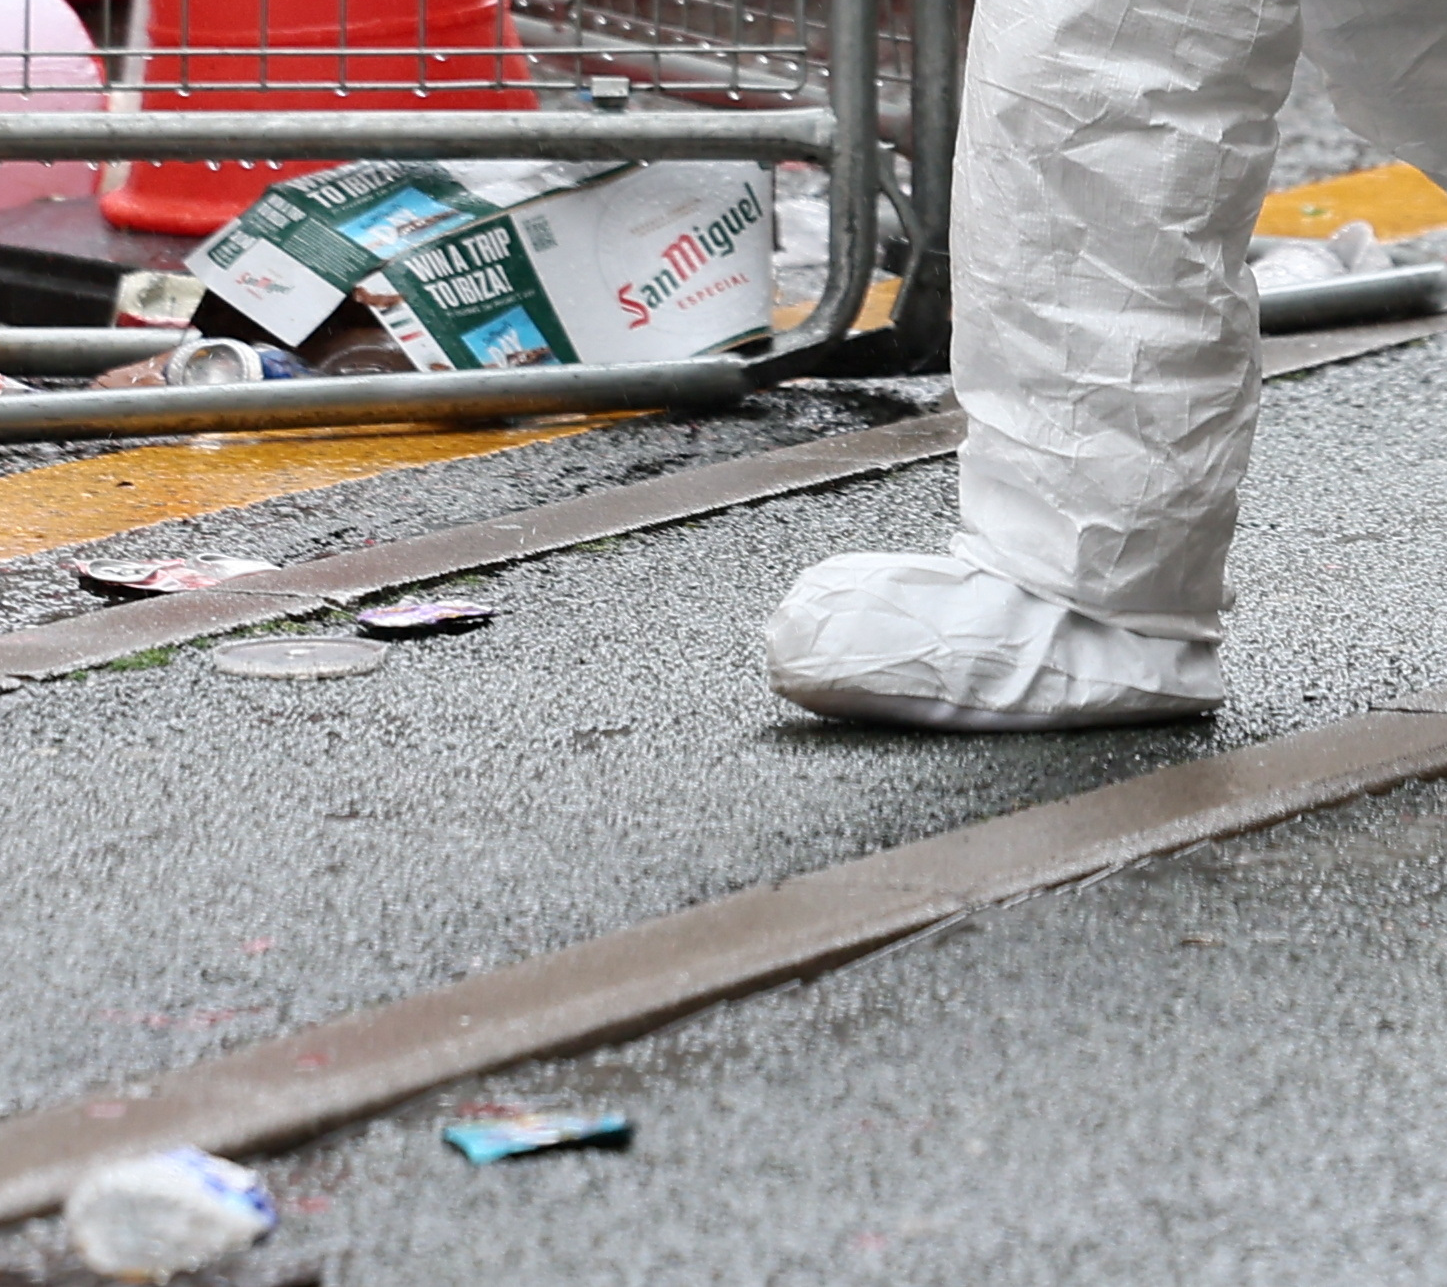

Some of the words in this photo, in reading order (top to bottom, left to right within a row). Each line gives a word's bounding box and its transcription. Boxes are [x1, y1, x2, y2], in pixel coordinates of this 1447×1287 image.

[404, 248, 455, 283] WIN
[447, 244, 470, 274] A
[462, 227, 512, 267] TRIP
[423, 281, 460, 310] TO
[452, 264, 514, 305] IBIZA!
[676, 272, 751, 311] ESPECIAL
